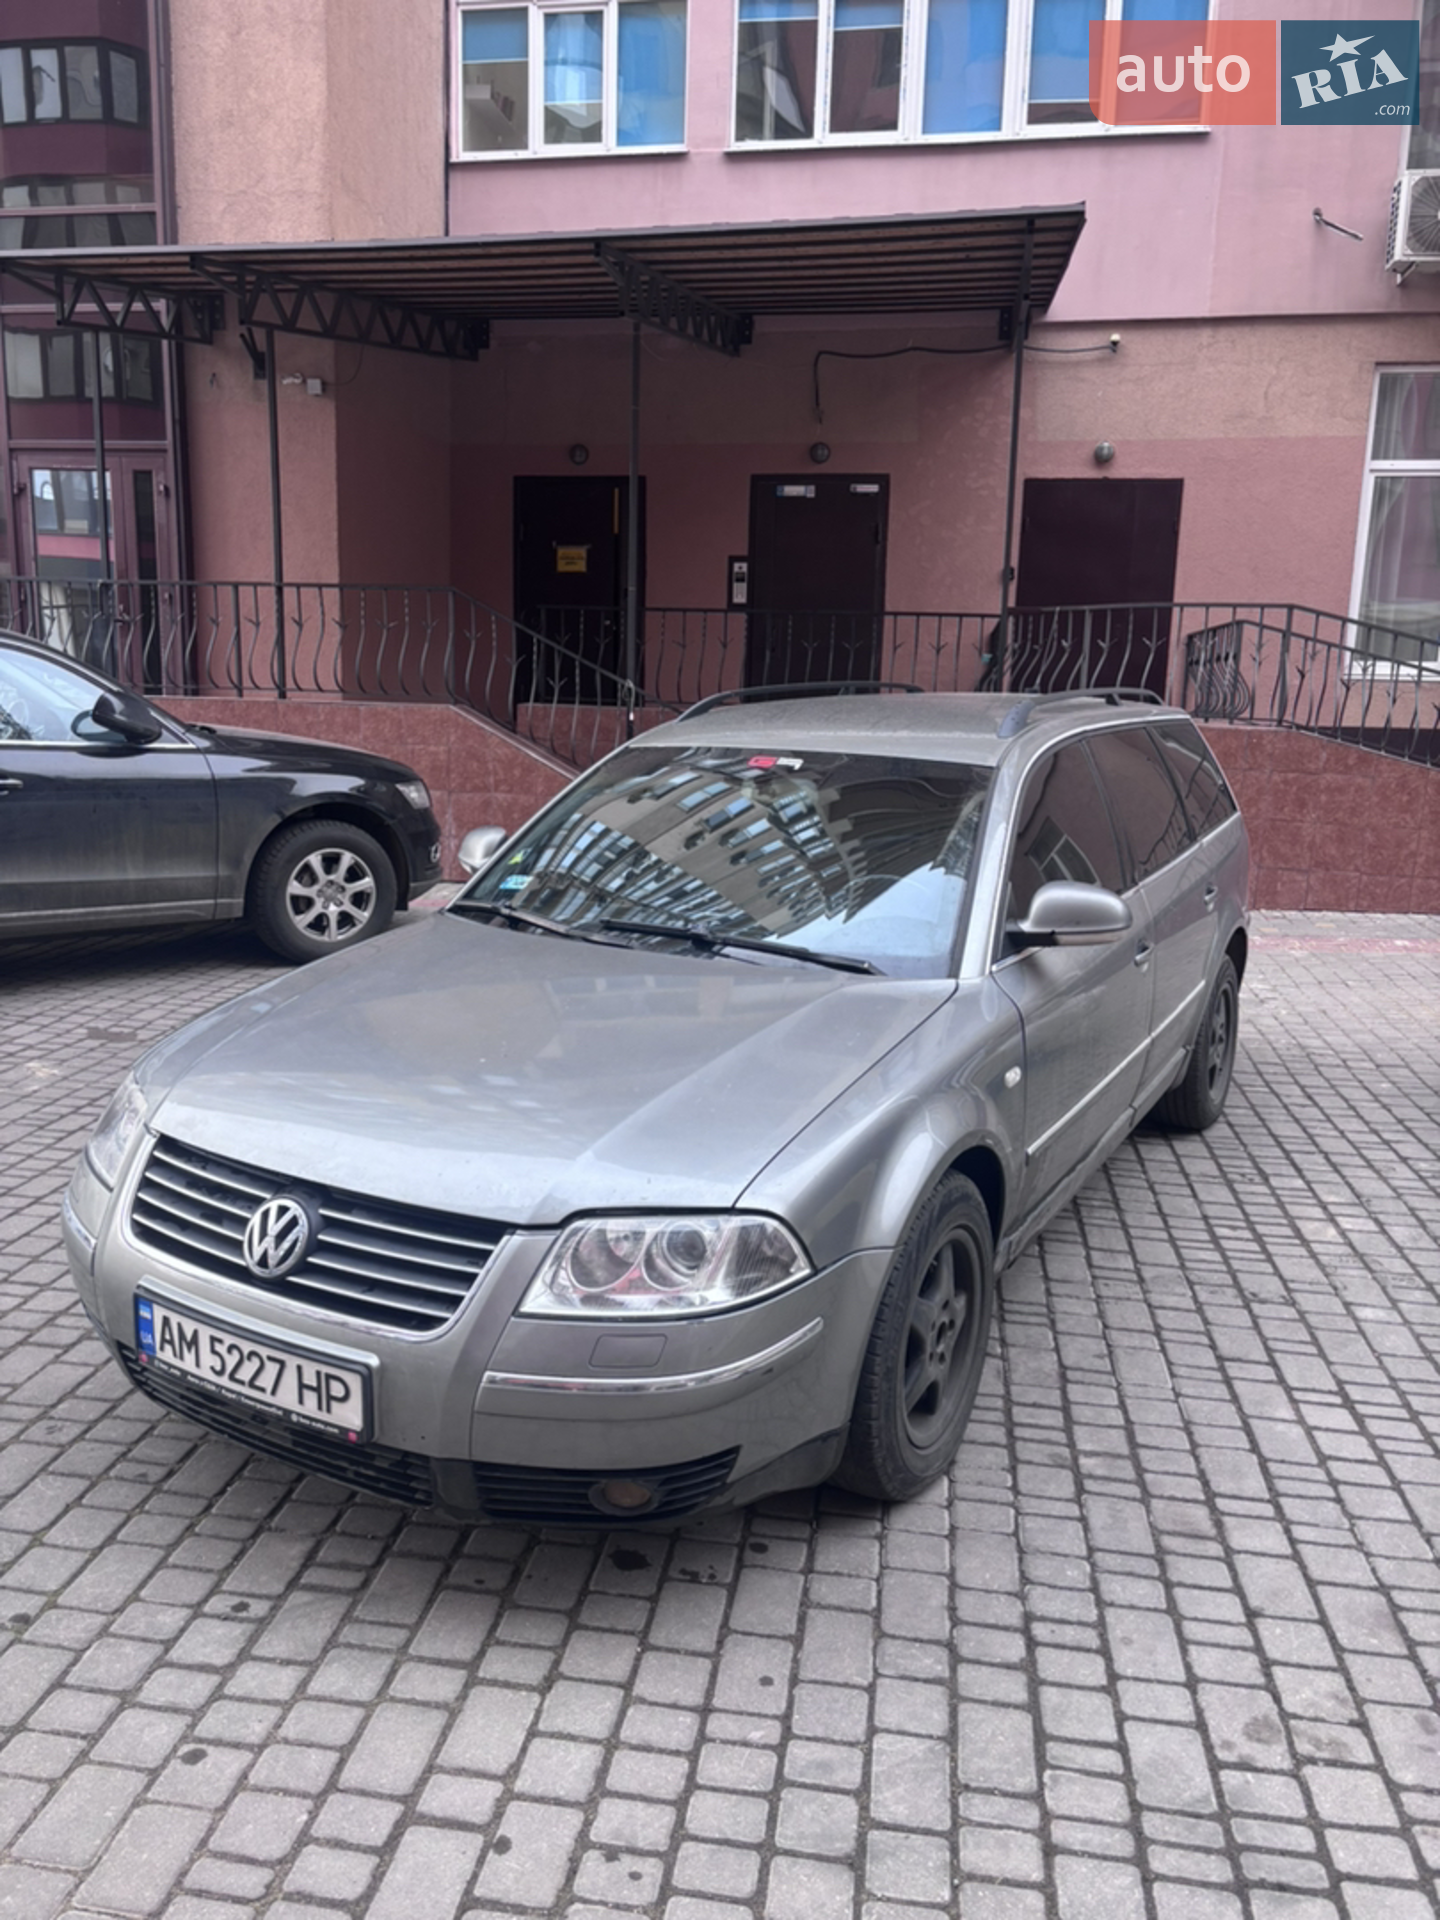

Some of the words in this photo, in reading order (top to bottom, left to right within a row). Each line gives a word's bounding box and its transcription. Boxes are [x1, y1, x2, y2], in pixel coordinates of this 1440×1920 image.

[159, 1315, 201, 1369] AM
[208, 1334, 286, 1397] 5227
[296, 1363, 351, 1415] HP
